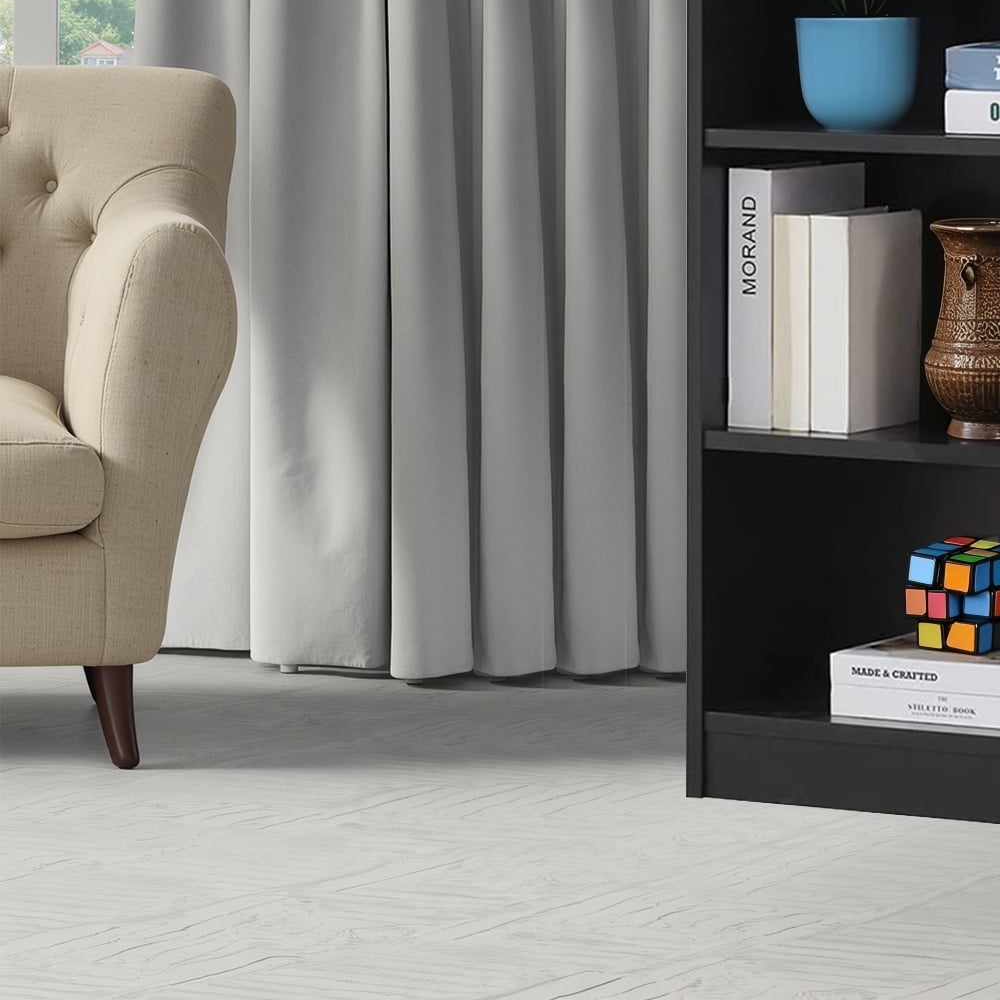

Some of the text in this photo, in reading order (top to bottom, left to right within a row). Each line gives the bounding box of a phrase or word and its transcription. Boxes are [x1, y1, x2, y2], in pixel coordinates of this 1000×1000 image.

[742, 196, 757, 295] MORAND
[851, 666, 938, 682] MADE & CRAFTED
[907, 703, 949, 713] STILETTO
[953, 707, 976, 716] BOOK
